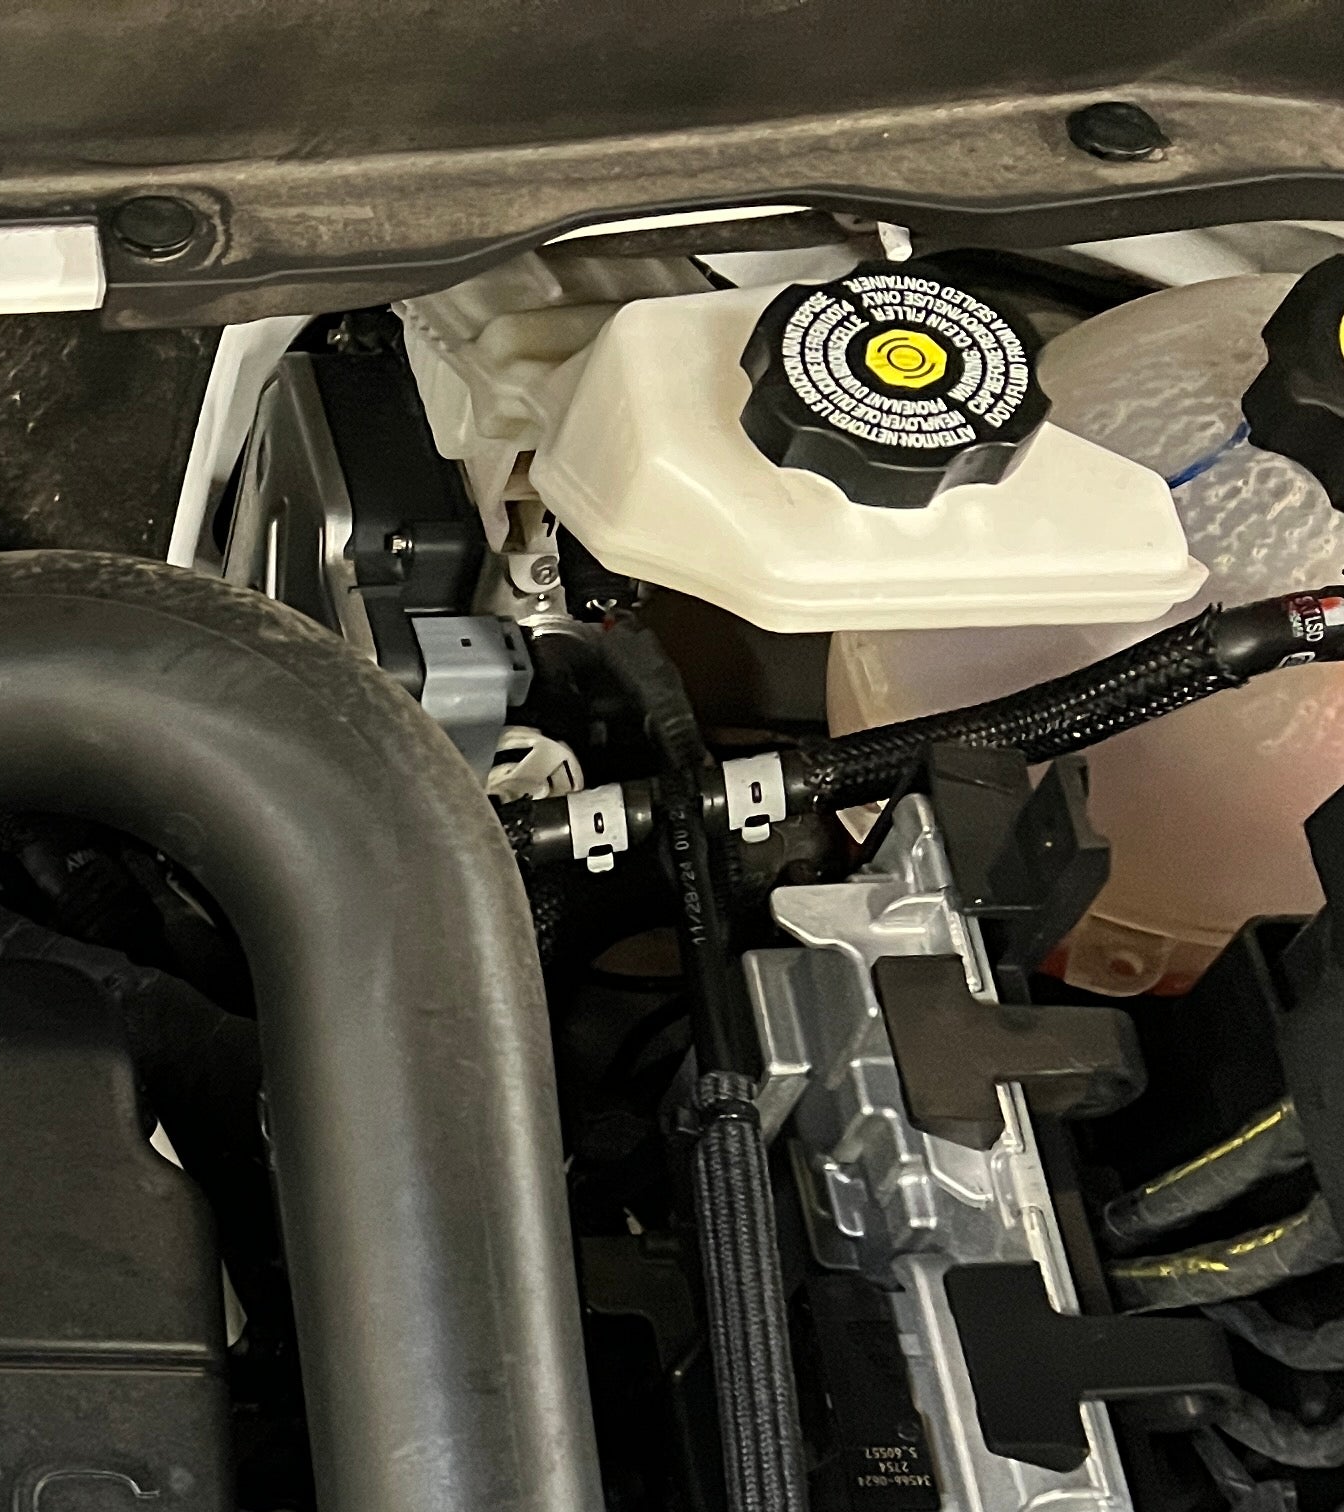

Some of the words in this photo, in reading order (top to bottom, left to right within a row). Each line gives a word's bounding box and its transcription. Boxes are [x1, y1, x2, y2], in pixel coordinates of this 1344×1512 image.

[861, 290, 902, 308] ONLY
[903, 290, 935, 310] USE
[940, 286, 998, 323] SEALED
[869, 305, 927, 323] FILLER
[989, 318, 1009, 330] A
[925, 313, 973, 348] CLEAN
[994, 327, 1027, 363] FROM
[1004, 363, 1042, 400] FLUID
[810, 398, 835, 417] LE
[966, 388, 995, 415] CAP
[1304, 616, 1324, 642] LSD
